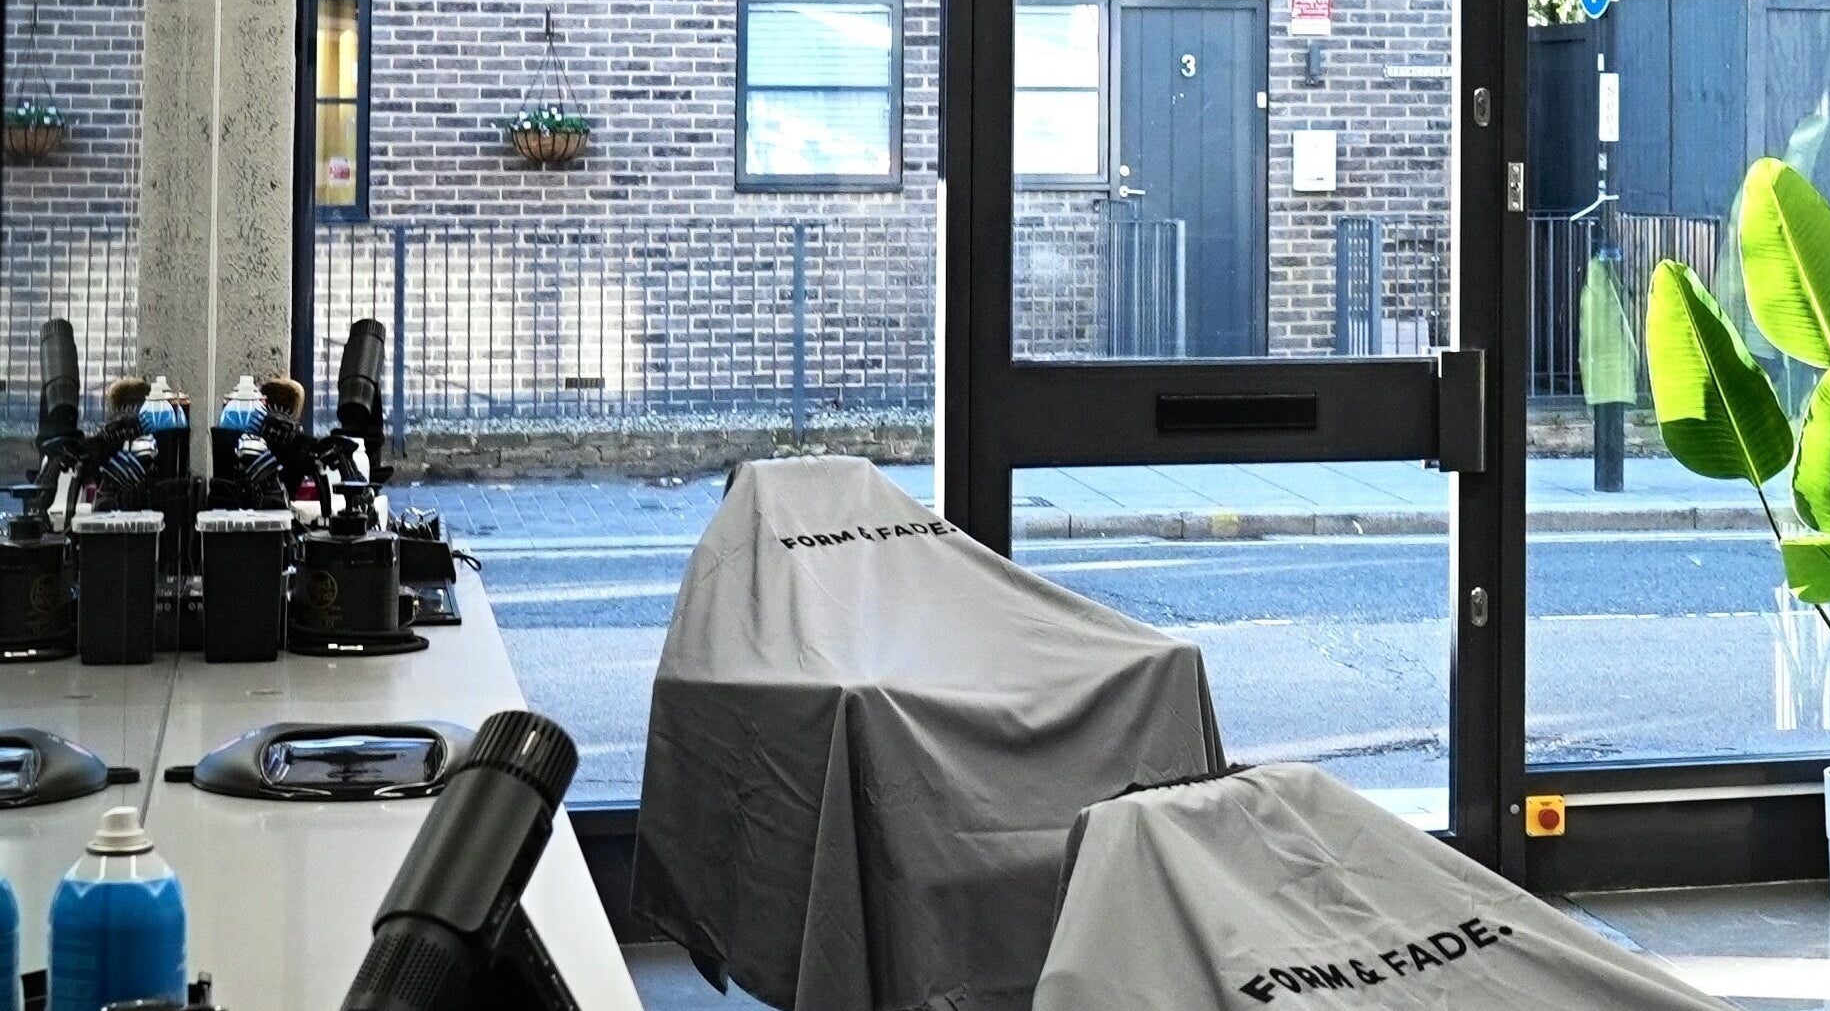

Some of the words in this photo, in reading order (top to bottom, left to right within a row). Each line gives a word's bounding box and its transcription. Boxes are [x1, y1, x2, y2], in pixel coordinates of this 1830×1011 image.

[1181, 54, 1196, 77] 3
[780, 530, 856, 550] FORM
[857, 526, 875, 541] &
[875, 521, 957, 540] FADE.
[1239, 962, 1354, 1003] FORM
[1348, 958, 1387, 984] &
[1379, 917, 1514, 978] FADE.
